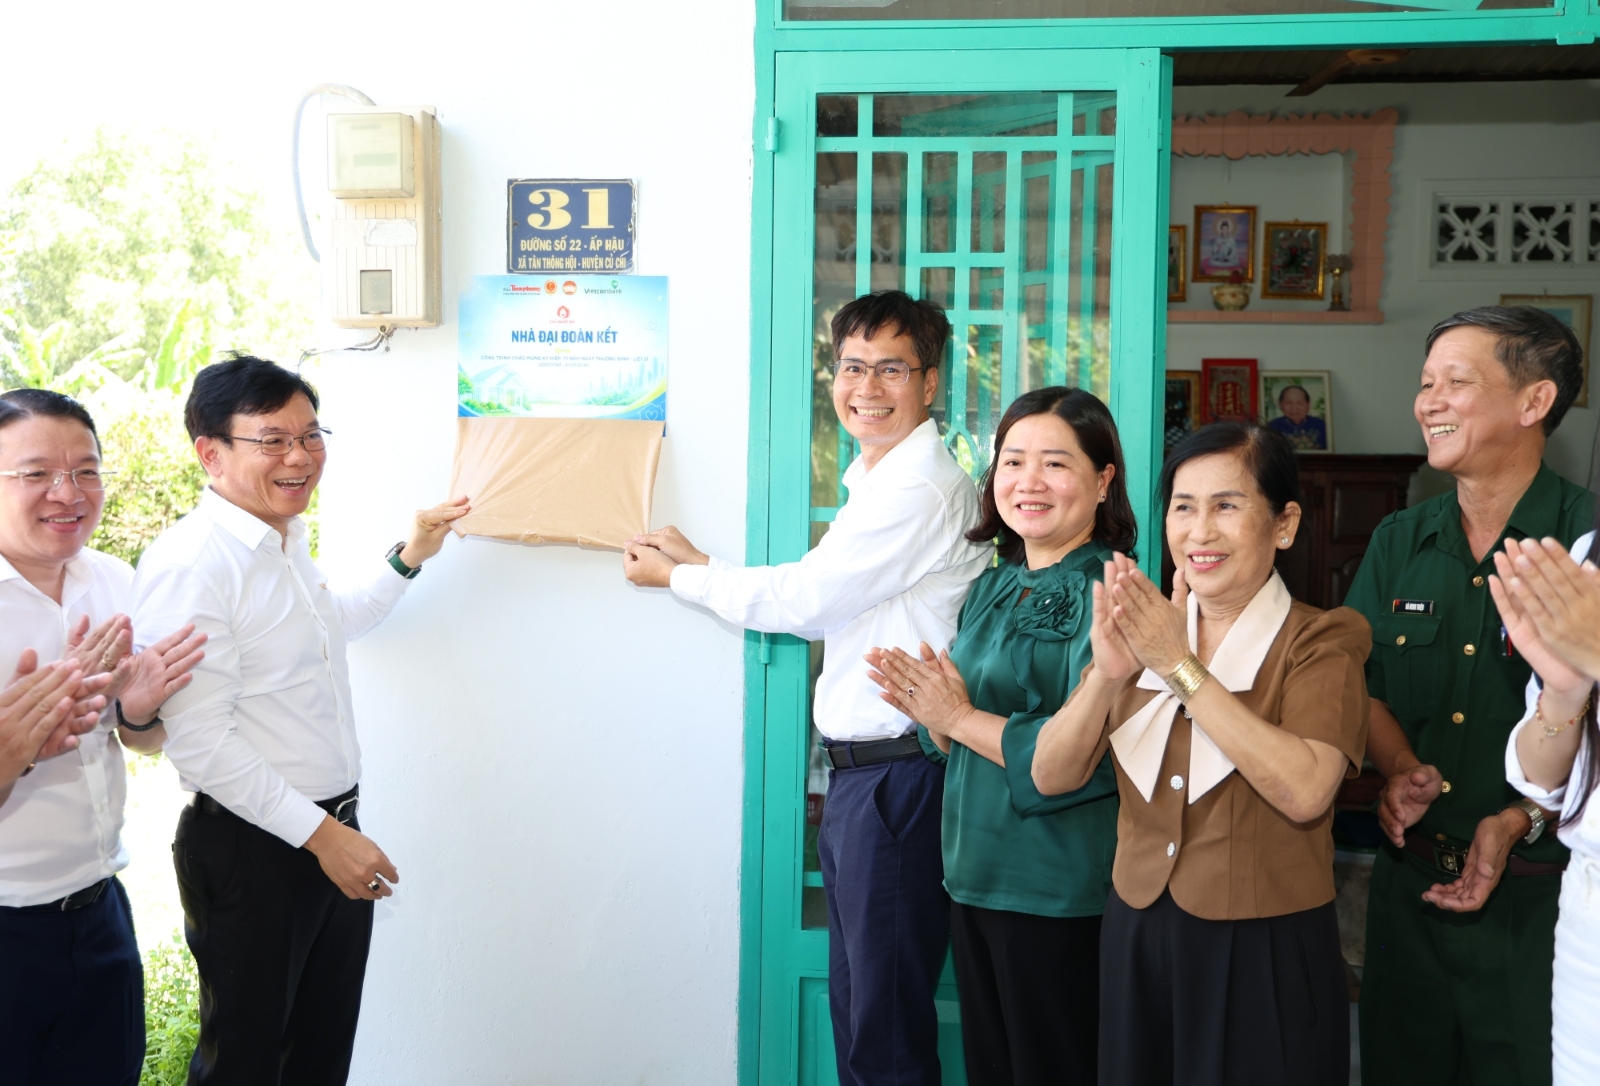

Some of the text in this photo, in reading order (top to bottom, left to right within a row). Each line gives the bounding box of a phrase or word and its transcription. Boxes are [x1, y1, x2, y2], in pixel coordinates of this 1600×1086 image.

[527, 188, 614, 230] 31
[520, 237, 552, 251] ĐƯỜNG
[554, 235, 568, 251] SỐ
[569, 239, 581, 251] 22
[589, 235, 602, 251] ẤP
[605, 237, 624, 253] HẬU
[518, 255, 527, 269] XÃ
[528, 255, 541, 269] TÂN
[542, 255, 564, 269] THÔNG
[565, 255, 577, 270] HỘI
[582, 255, 603, 270] HUYỆN
[605, 253, 614, 269] CỦ
[615, 257, 626, 269] CHI
[511, 326, 618, 346] NHÀ ĐẠI ĐOÀN KẾT
